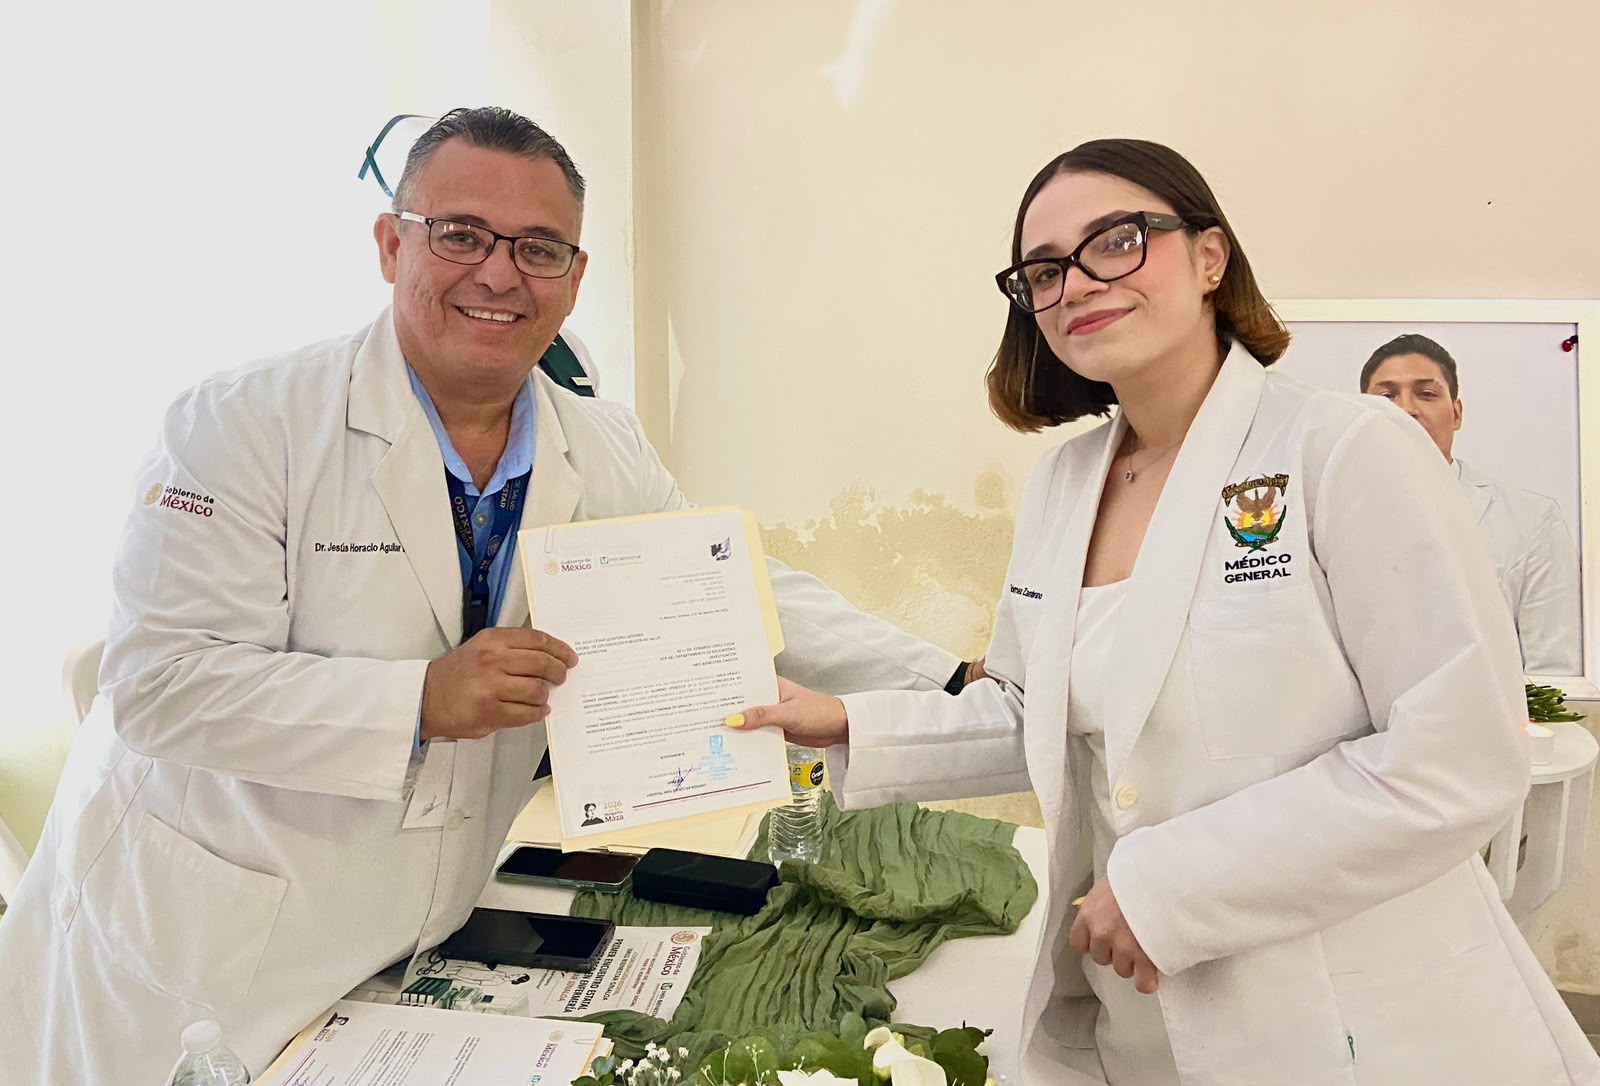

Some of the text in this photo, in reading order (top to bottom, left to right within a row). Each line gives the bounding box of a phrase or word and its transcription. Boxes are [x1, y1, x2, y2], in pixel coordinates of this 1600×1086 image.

[160, 494, 213, 517] México
[204, 496, 214, 504] de
[314, 542, 326, 552] Dr.
[328, 542, 349, 552] Jesús
[350, 543, 378, 552] Horacio
[380, 542, 401, 554] Aguilar
[562, 564, 592, 572] México
[1225, 554, 1292, 570] MÉDICO
[1224, 568, 1291, 583] GENERAL
[607, 939, 624, 958] PRIMER
[660, 946, 683, 976] México
[590, 959, 613, 989] ENCUENTRO
[563, 980, 589, 1013] ENFERMERÍA
[578, 990, 596, 1010] ESTATAL
[536, 1043, 554, 1067] México
